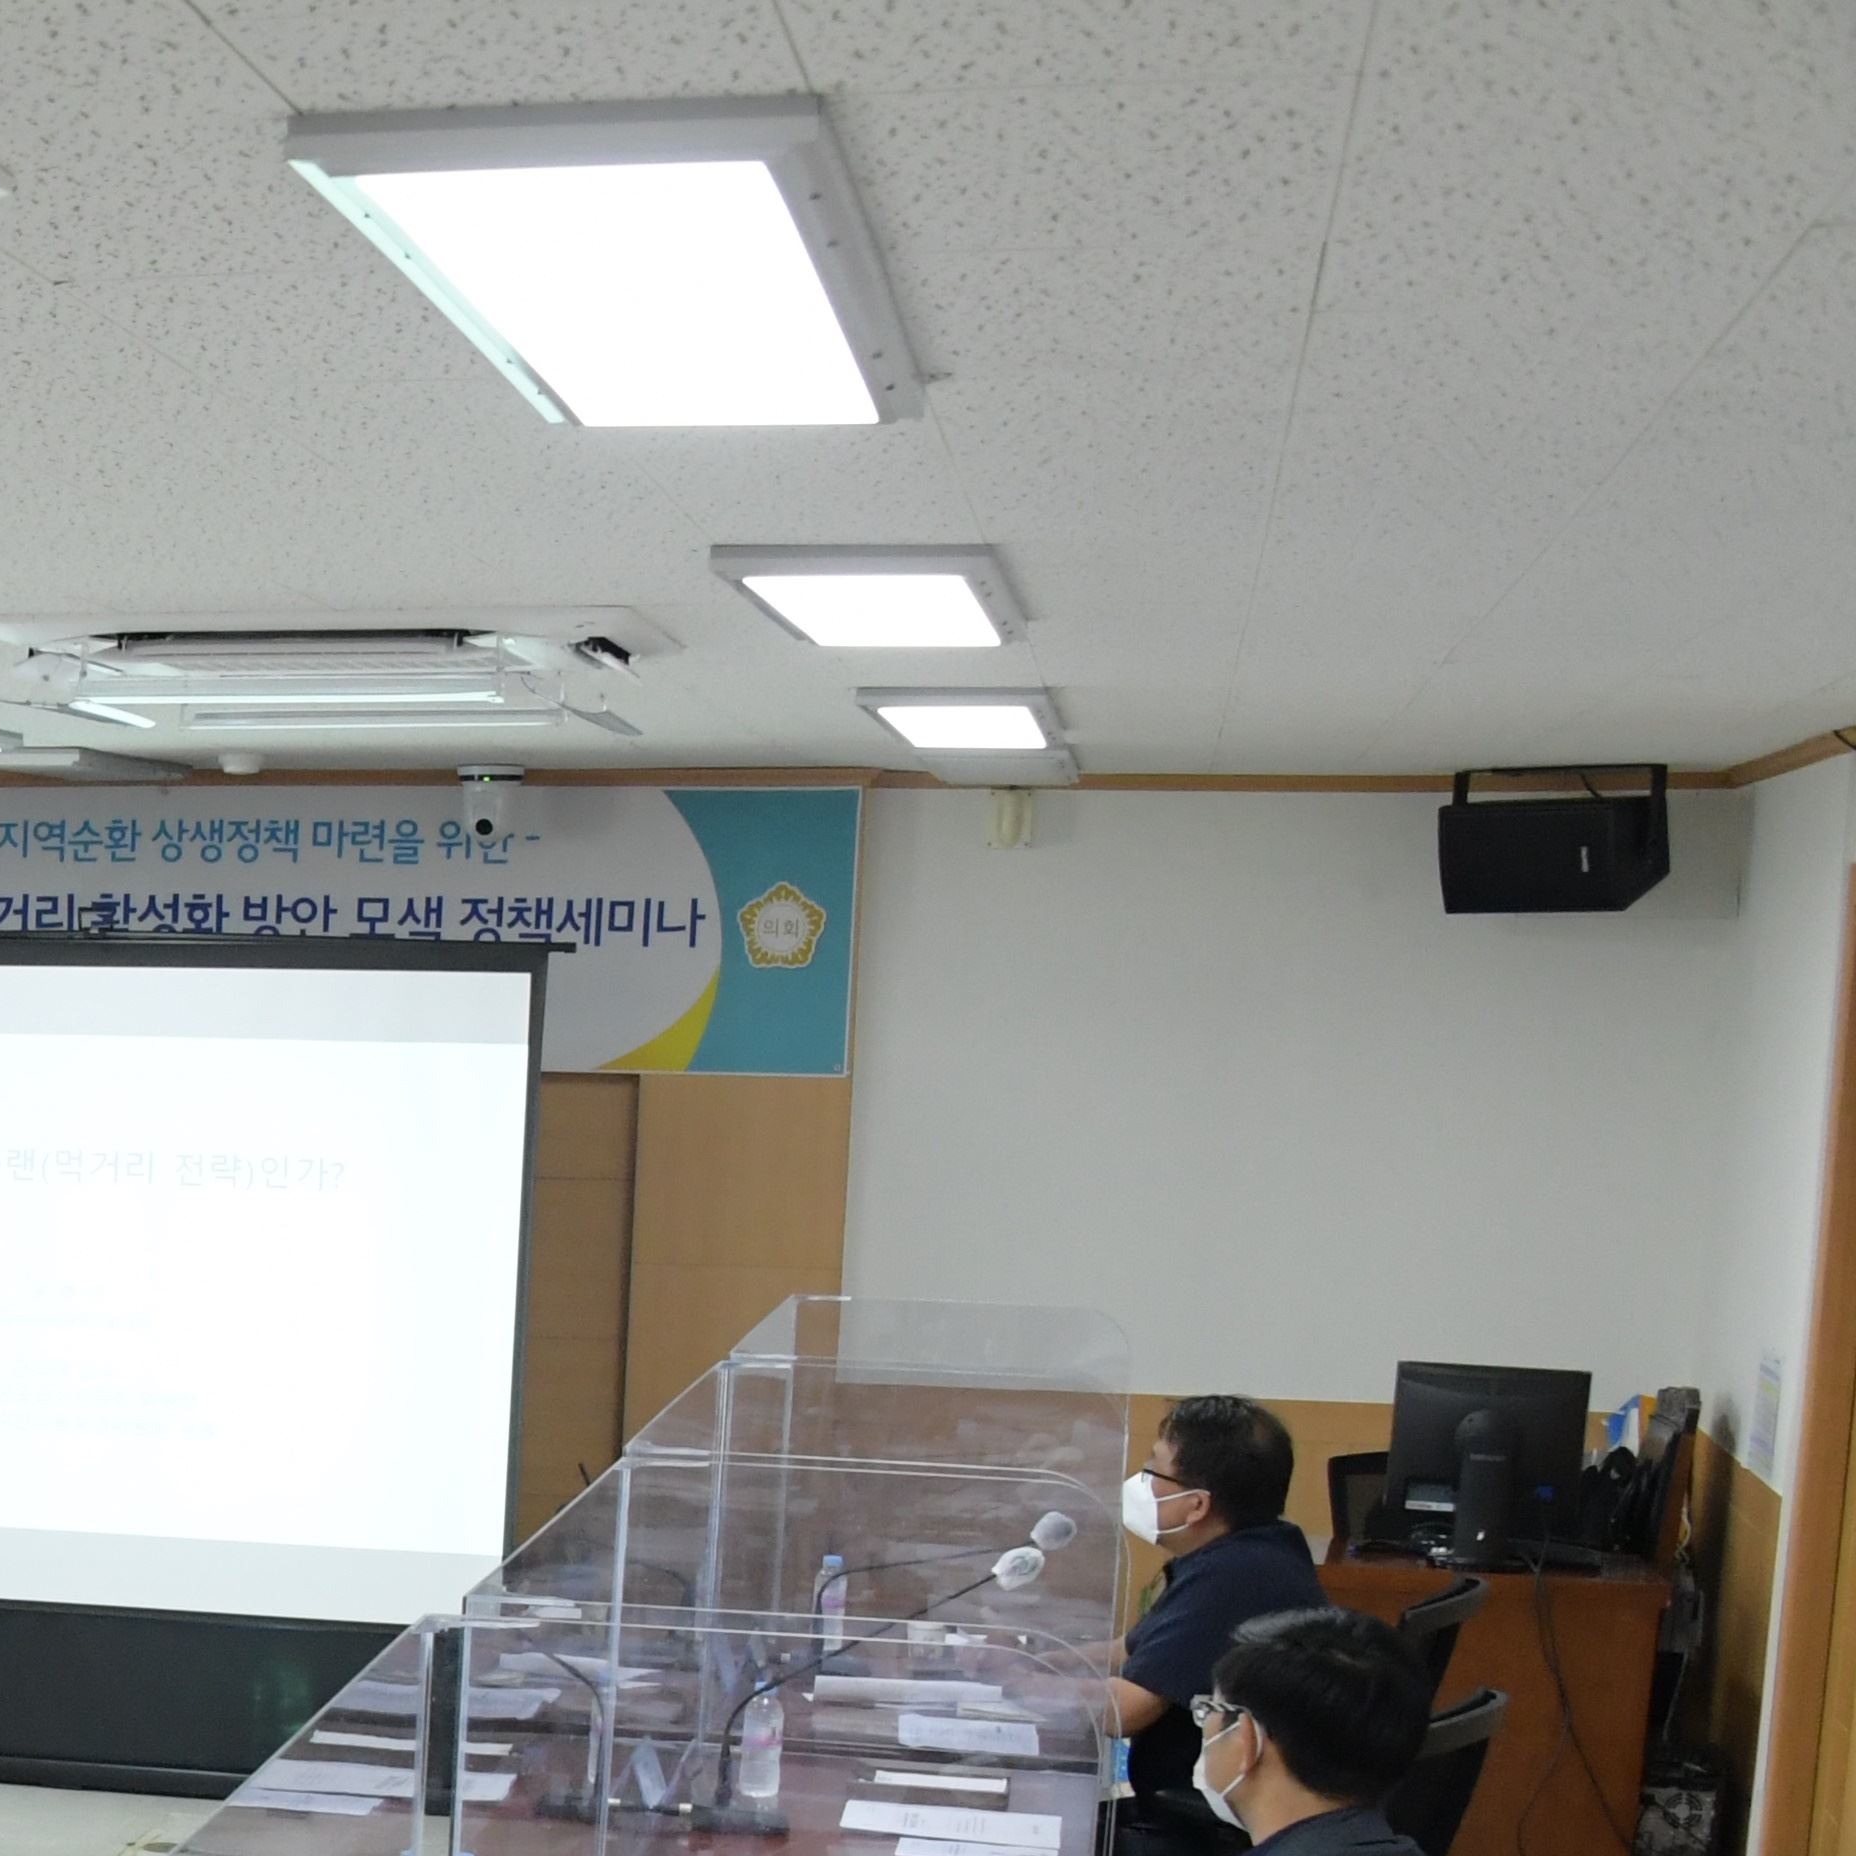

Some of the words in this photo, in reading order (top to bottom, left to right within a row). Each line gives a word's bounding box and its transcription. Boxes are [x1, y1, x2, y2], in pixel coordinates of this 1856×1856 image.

[151, 818, 300, 865] 상생정책
[312, 818, 424, 865] 마련을
[242, 893, 338, 937] 방안
[349, 894, 444, 941] 모색
[459, 895, 707, 948] 정책세미나
